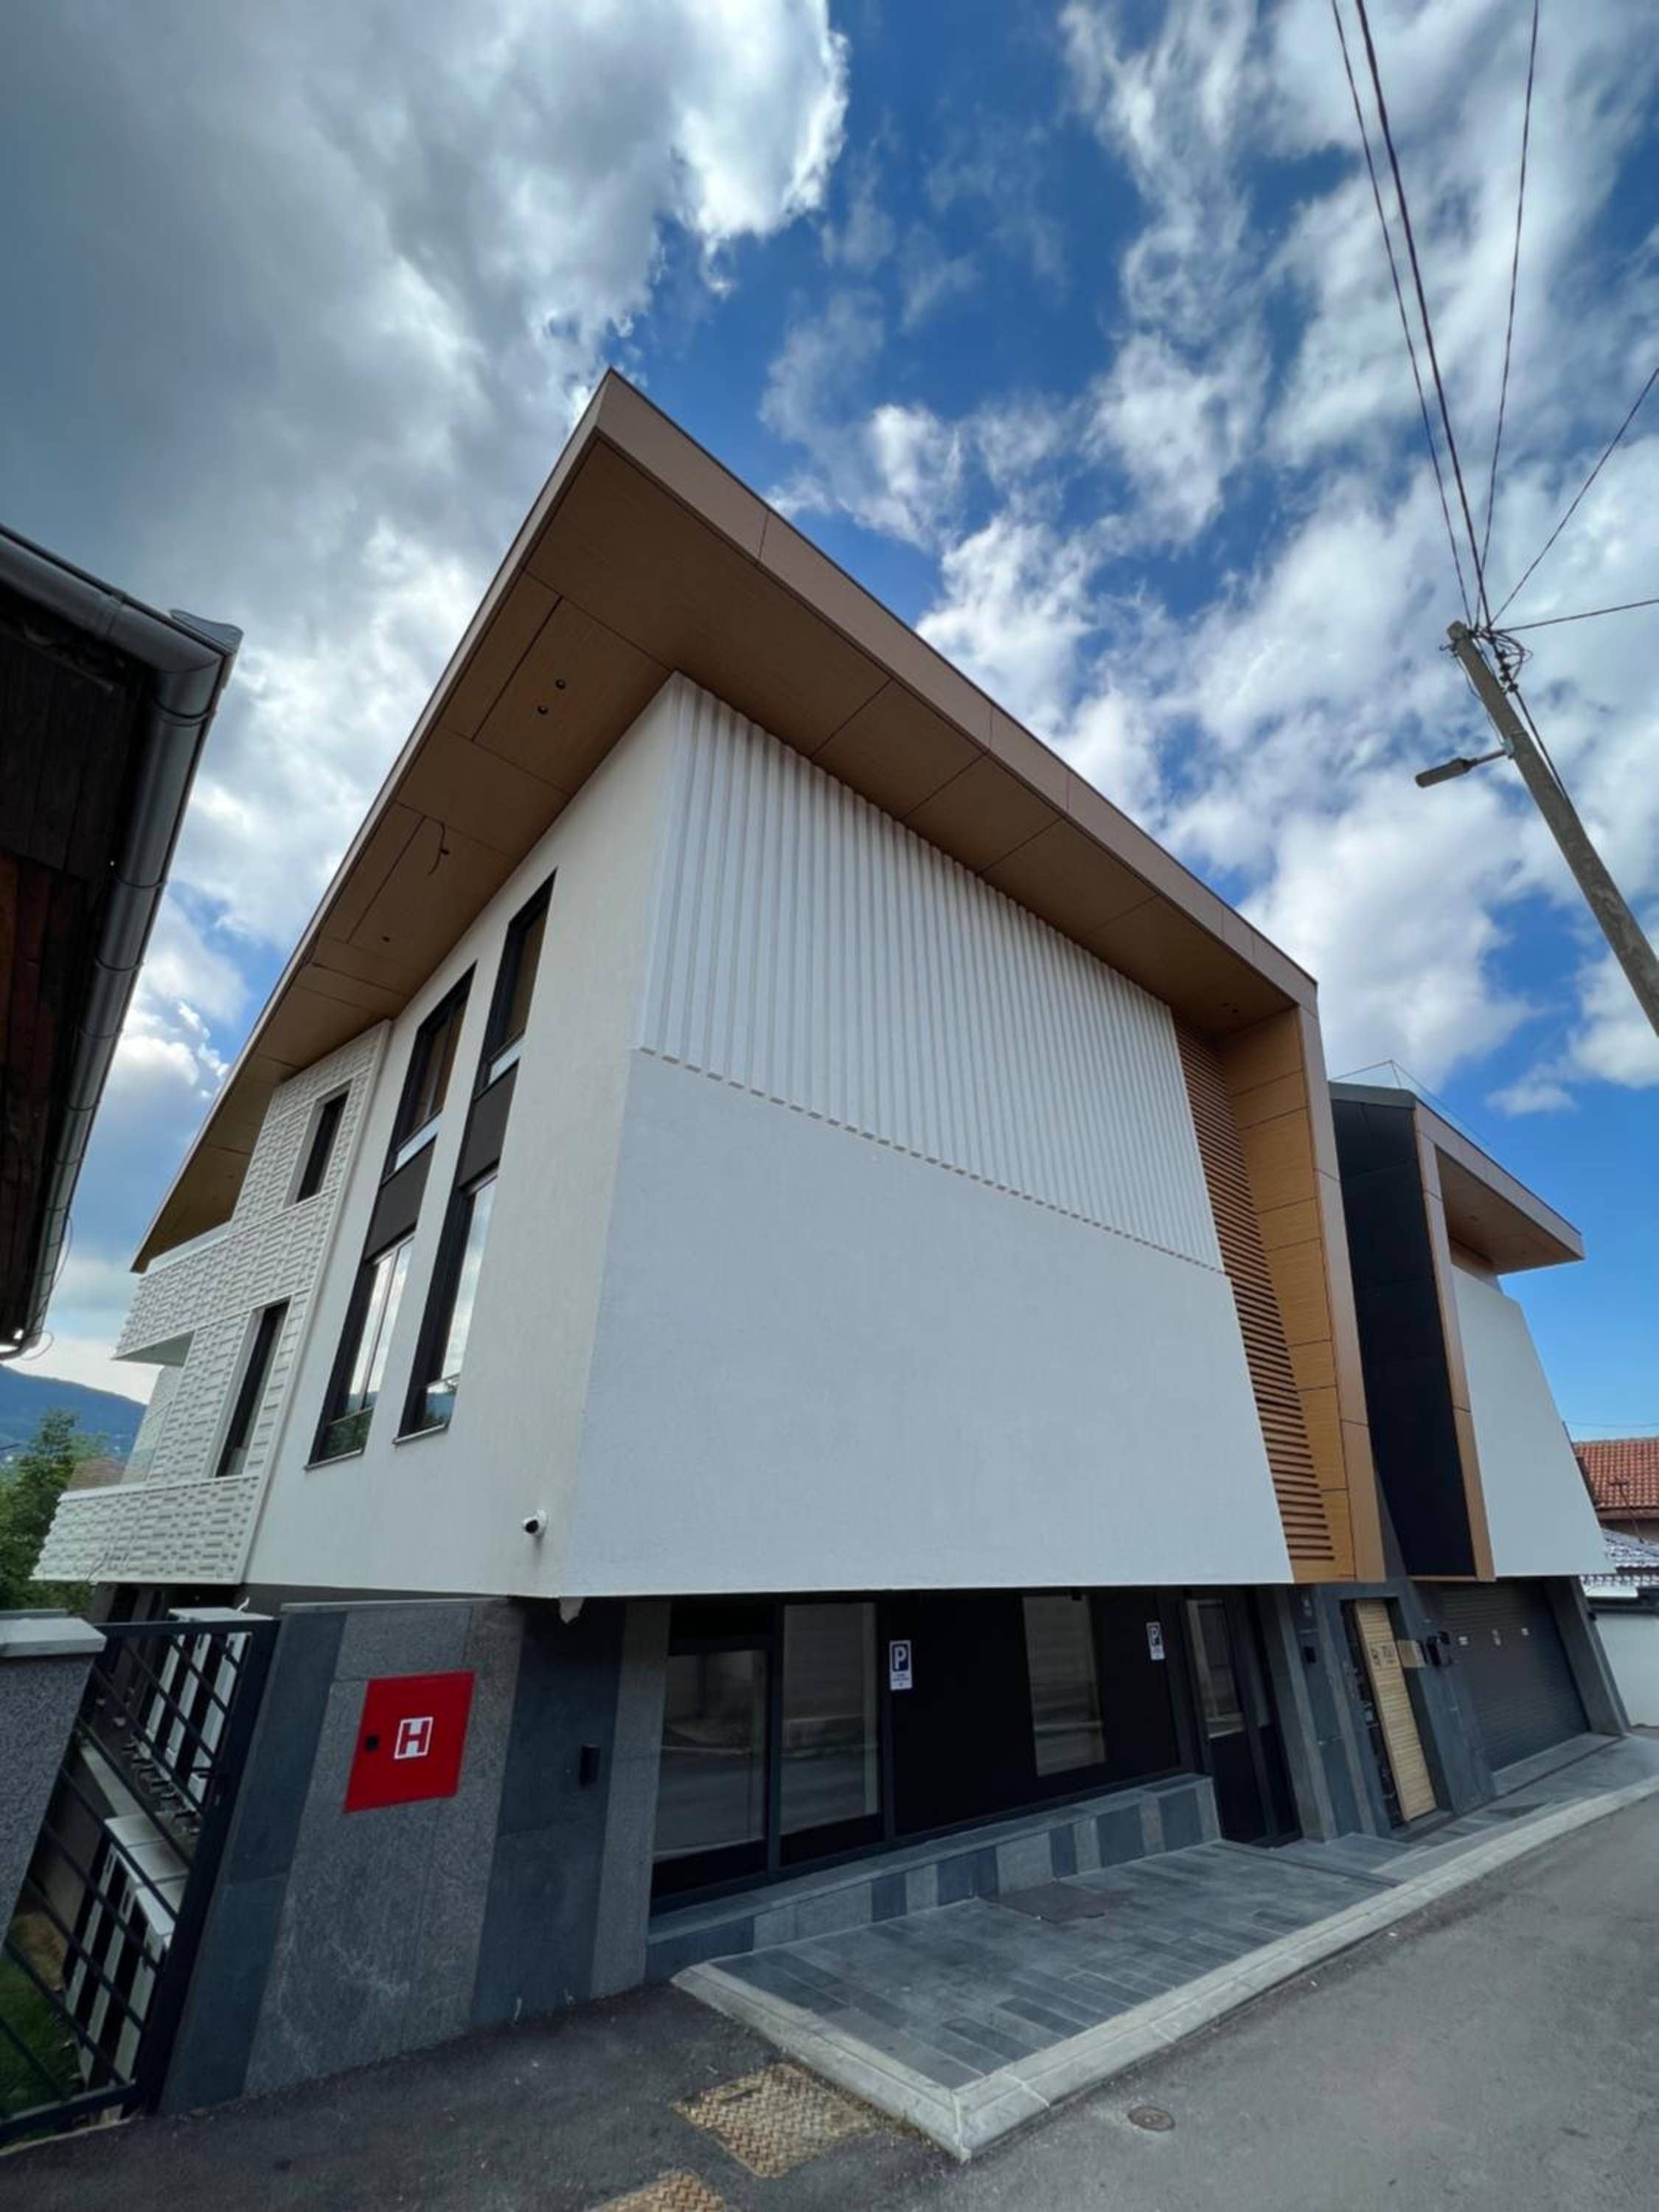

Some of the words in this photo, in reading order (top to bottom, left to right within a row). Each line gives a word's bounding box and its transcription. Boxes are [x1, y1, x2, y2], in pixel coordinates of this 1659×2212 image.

[1150, 1627, 1158, 1644] P
[894, 1646, 907, 1670] P
[398, 1720, 430, 1755] H
